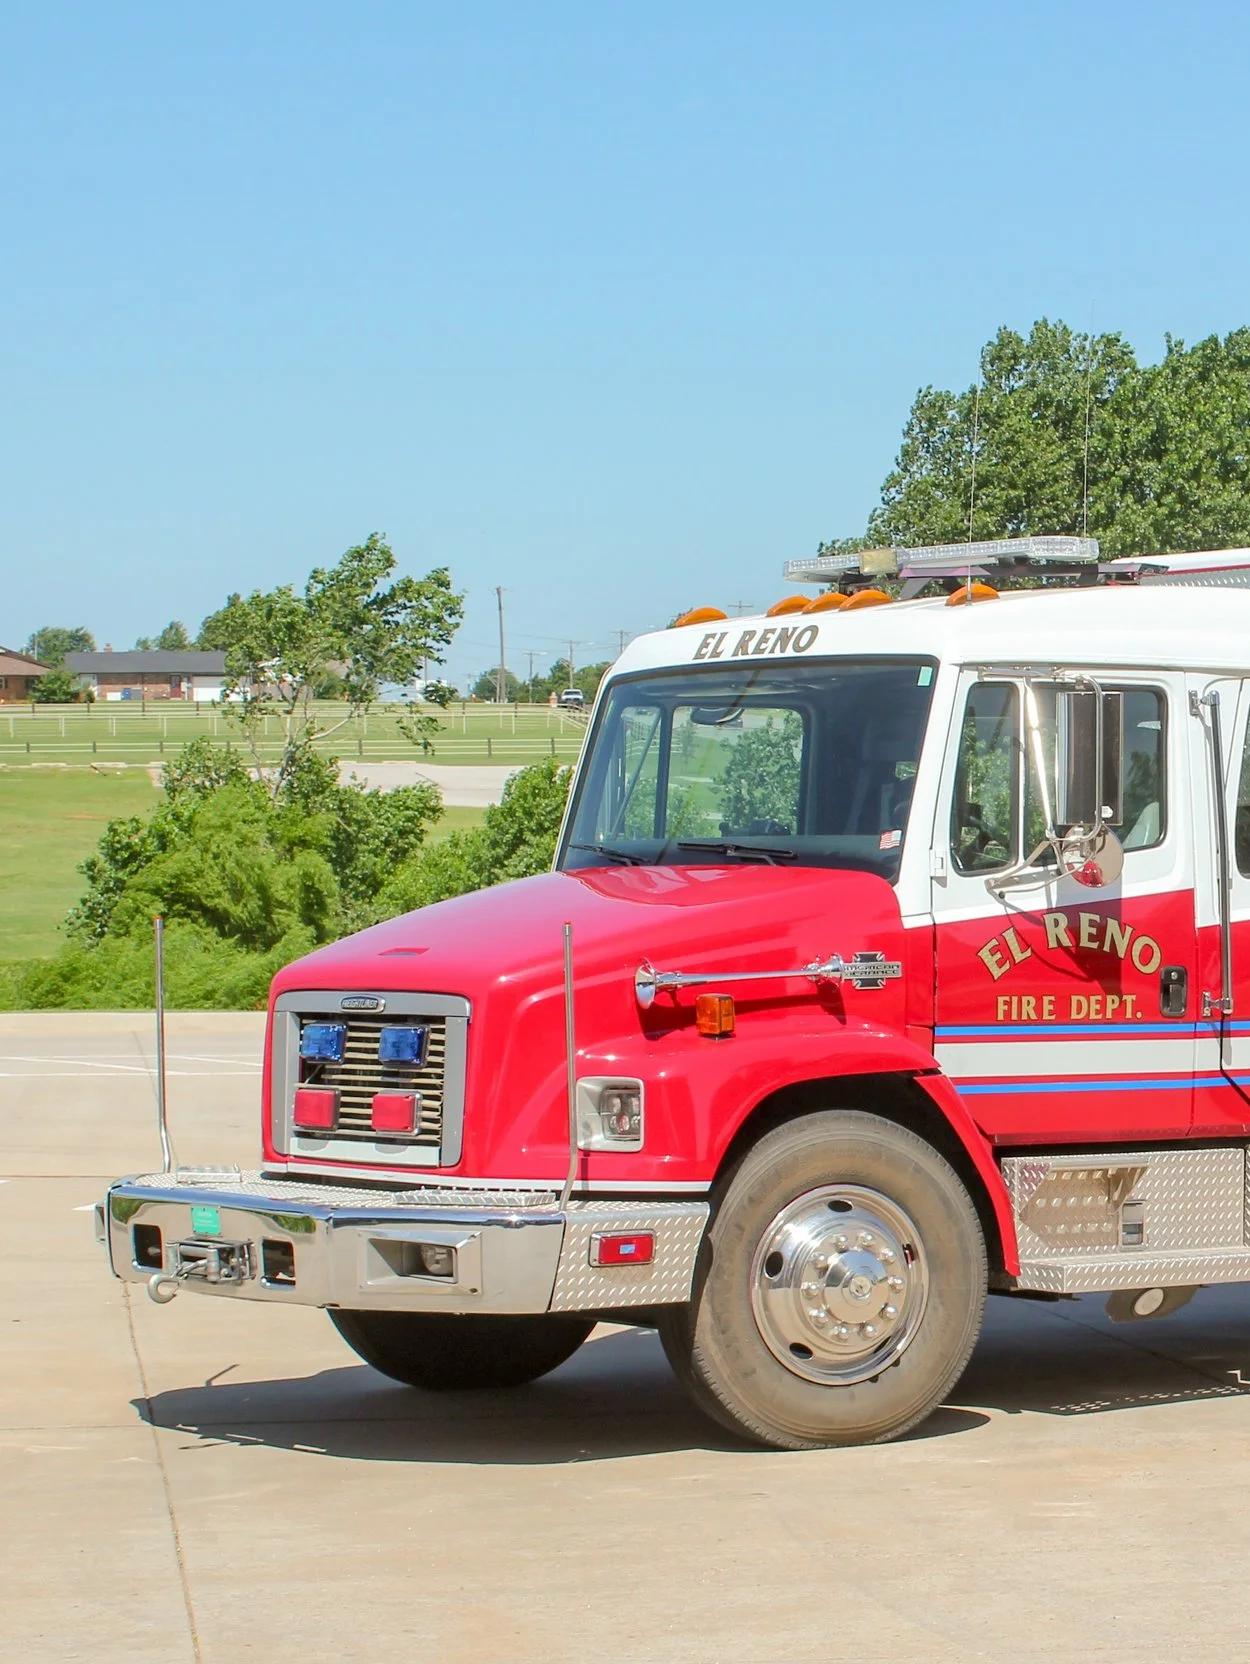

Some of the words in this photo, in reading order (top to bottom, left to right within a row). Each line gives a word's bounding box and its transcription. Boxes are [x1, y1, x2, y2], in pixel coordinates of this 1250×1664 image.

[692, 631, 729, 660] EL
[731, 624, 819, 657] RENO
[976, 926, 1033, 982] EL
[1042, 911, 1162, 975] RENO
[996, 995, 1057, 1021] FIRE
[1069, 994, 1143, 1021] DEPT.
